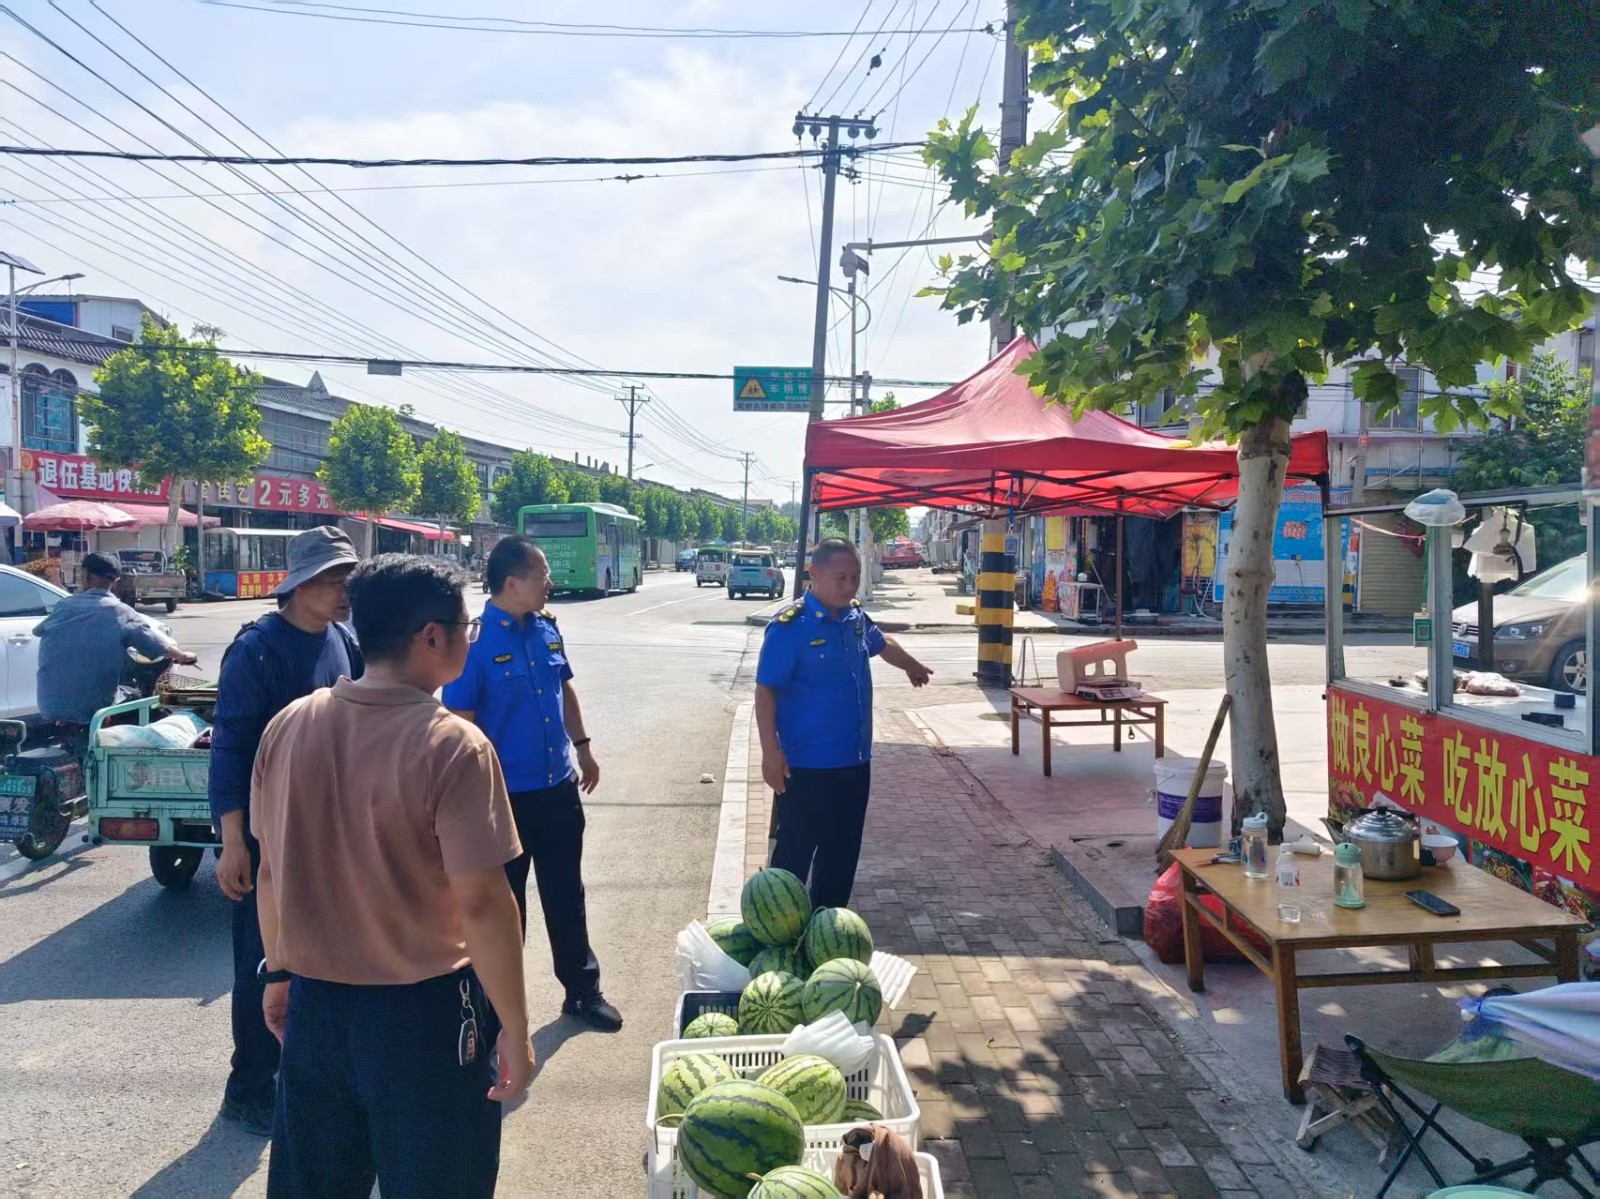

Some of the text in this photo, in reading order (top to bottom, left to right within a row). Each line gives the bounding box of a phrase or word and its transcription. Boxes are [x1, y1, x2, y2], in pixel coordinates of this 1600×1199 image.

[1331, 696, 1592, 874] 做良心菜 吃放心菜
